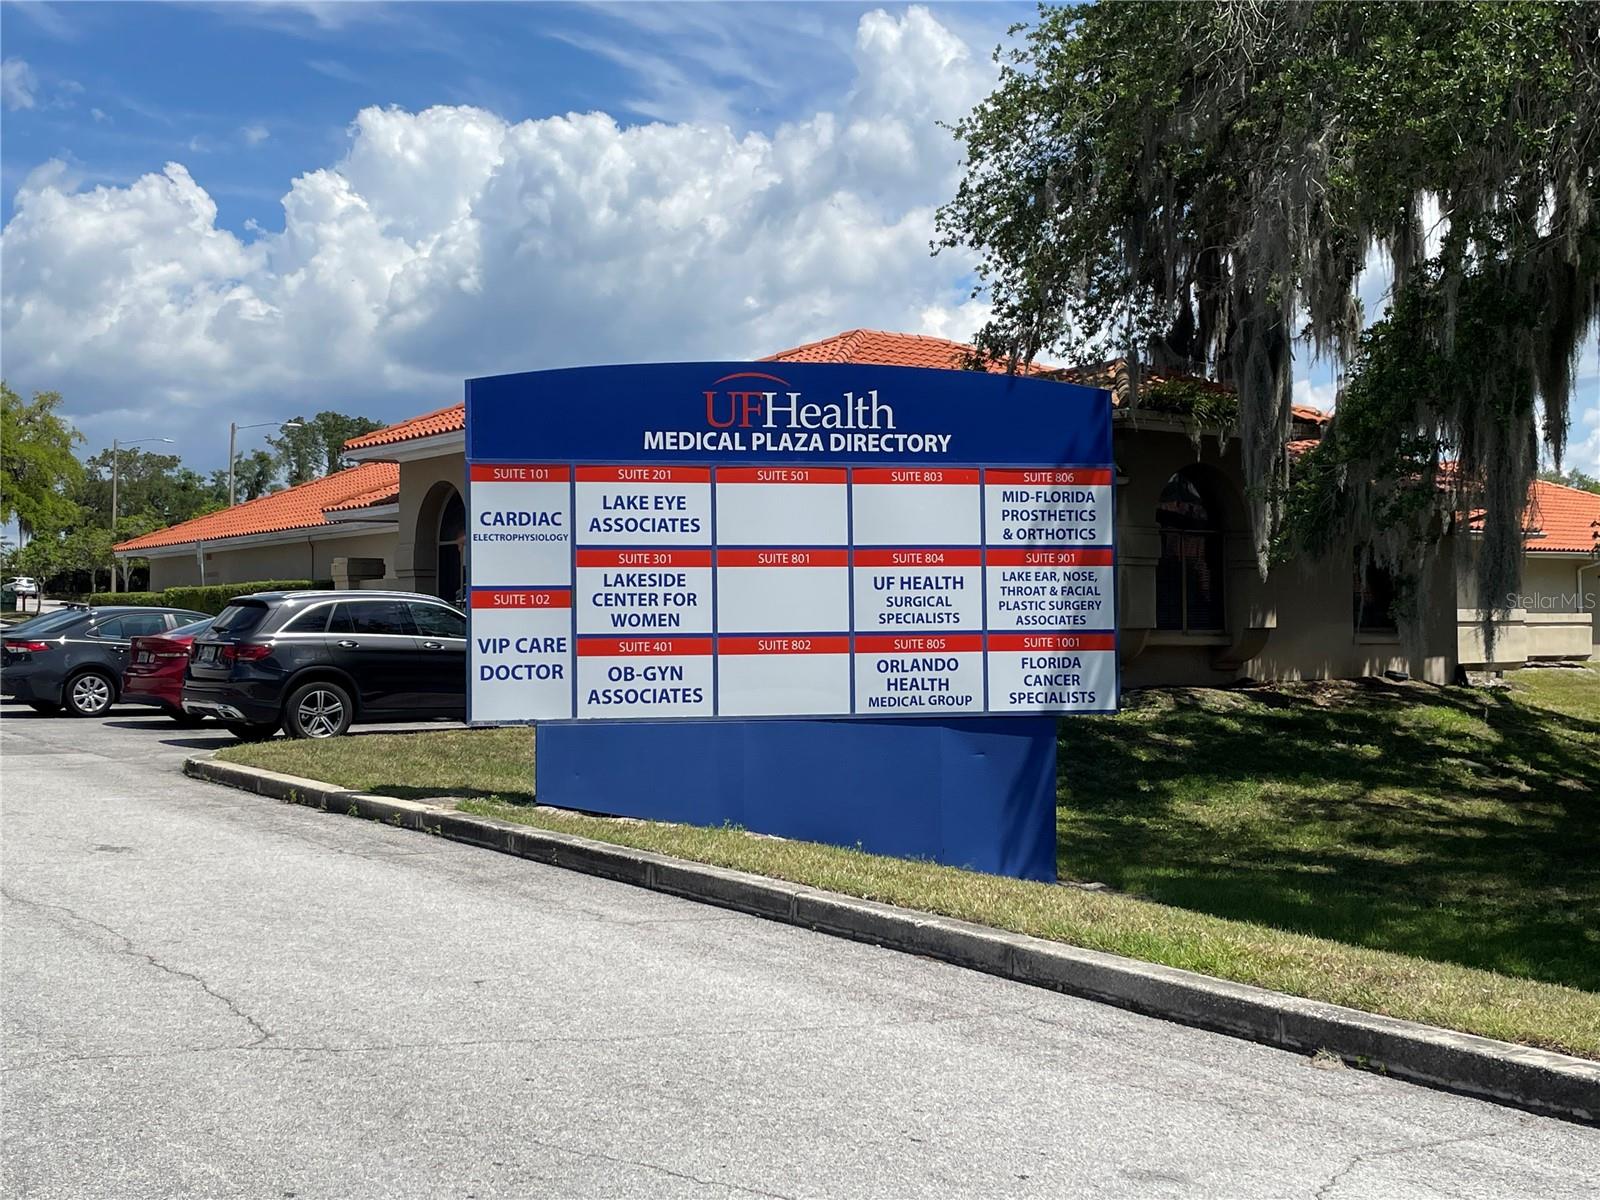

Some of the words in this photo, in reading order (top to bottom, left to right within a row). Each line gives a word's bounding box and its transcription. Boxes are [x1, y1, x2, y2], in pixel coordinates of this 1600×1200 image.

[644, 432, 746, 450] MEDICAL
[752, 433, 824, 451] PLAZA
[830, 434, 951, 452] DIRECTORY
[494, 469, 526, 479] SUITE
[531, 469, 548, 479] 101
[618, 469, 649, 479] SUITE
[653, 470, 670, 479] 201
[758, 471, 787, 480] SUITE
[791, 471, 808, 480] 501
[892, 472, 921, 481] SUITE
[924, 472, 942, 481] 803
[1024, 472, 1052, 482] SUITE
[1055, 473, 1074, 482] 806
[603, 496, 648, 510] LAKE
[655, 496, 686, 510] EYE
[1003, 491, 1095, 503] MID-FLORIDA
[480, 512, 562, 526] CARDIAC
[1003, 510, 1096, 521] PROSTHETICS
[589, 518, 700, 532] ASSOCIATES
[1003, 528, 1012, 540] &
[1015, 528, 1096, 540] ORTHOTICS
[619, 554, 650, 564] SUITE
[653, 554, 671, 563] 301
[759, 554, 788, 563] SUITE
[792, 554, 809, 563] 801
[893, 553, 922, 563] SUITE
[925, 554, 944, 563] 804
[1026, 553, 1054, 563] SUITE
[1058, 554, 1074, 562] 901
[604, 574, 686, 587] LAKESIDE
[874, 577, 895, 590] UF
[901, 576, 963, 590] HEALTH
[1003, 572, 1031, 581] LAKE
[1035, 572, 1059, 582] EAR,
[1063, 571, 1098, 583] NOSE,
[1000, 586, 1047, 596] THROAT
[1050, 586, 1058, 596] &
[1060, 585, 1100, 596] FACIAL
[494, 594, 526, 605] SUITE
[531, 595, 549, 604] 102
[593, 593, 658, 606] CENTER
[664, 593, 697, 606] FOR
[887, 596, 952, 607] SURGICAL
[999, 601, 1045, 610] PLASTIC
[1048, 601, 1101, 611] SURGERY
[611, 614, 679, 627] WOMEN
[879, 613, 959, 624] SPECIALISTS
[1016, 615, 1086, 625] ASSOCIATES
[478, 639, 510, 654] VIP
[516, 638, 566, 653] CARE
[619, 642, 650, 652] SUITE
[653, 642, 671, 651] 401
[759, 640, 788, 650] SUITE
[792, 640, 811, 650] 802
[895, 639, 923, 649] SUITE
[927, 639, 945, 649] 805
[1024, 638, 1053, 647] SUITE
[1057, 638, 1079, 647] 1001
[877, 658, 958, 673] ORLANDO
[1022, 657, 1081, 669] FLORIDA
[481, 664, 563, 680] DOCTOR
[608, 666, 682, 681] OB-GYN
[887, 678, 949, 691] HEALTH
[1024, 674, 1080, 686] CANCER
[588, 688, 702, 704] ASSOCIATES
[869, 696, 925, 707] MEDICAL
[929, 695, 972, 706] GROUP
[1010, 691, 1095, 704] SPECIALISTS
